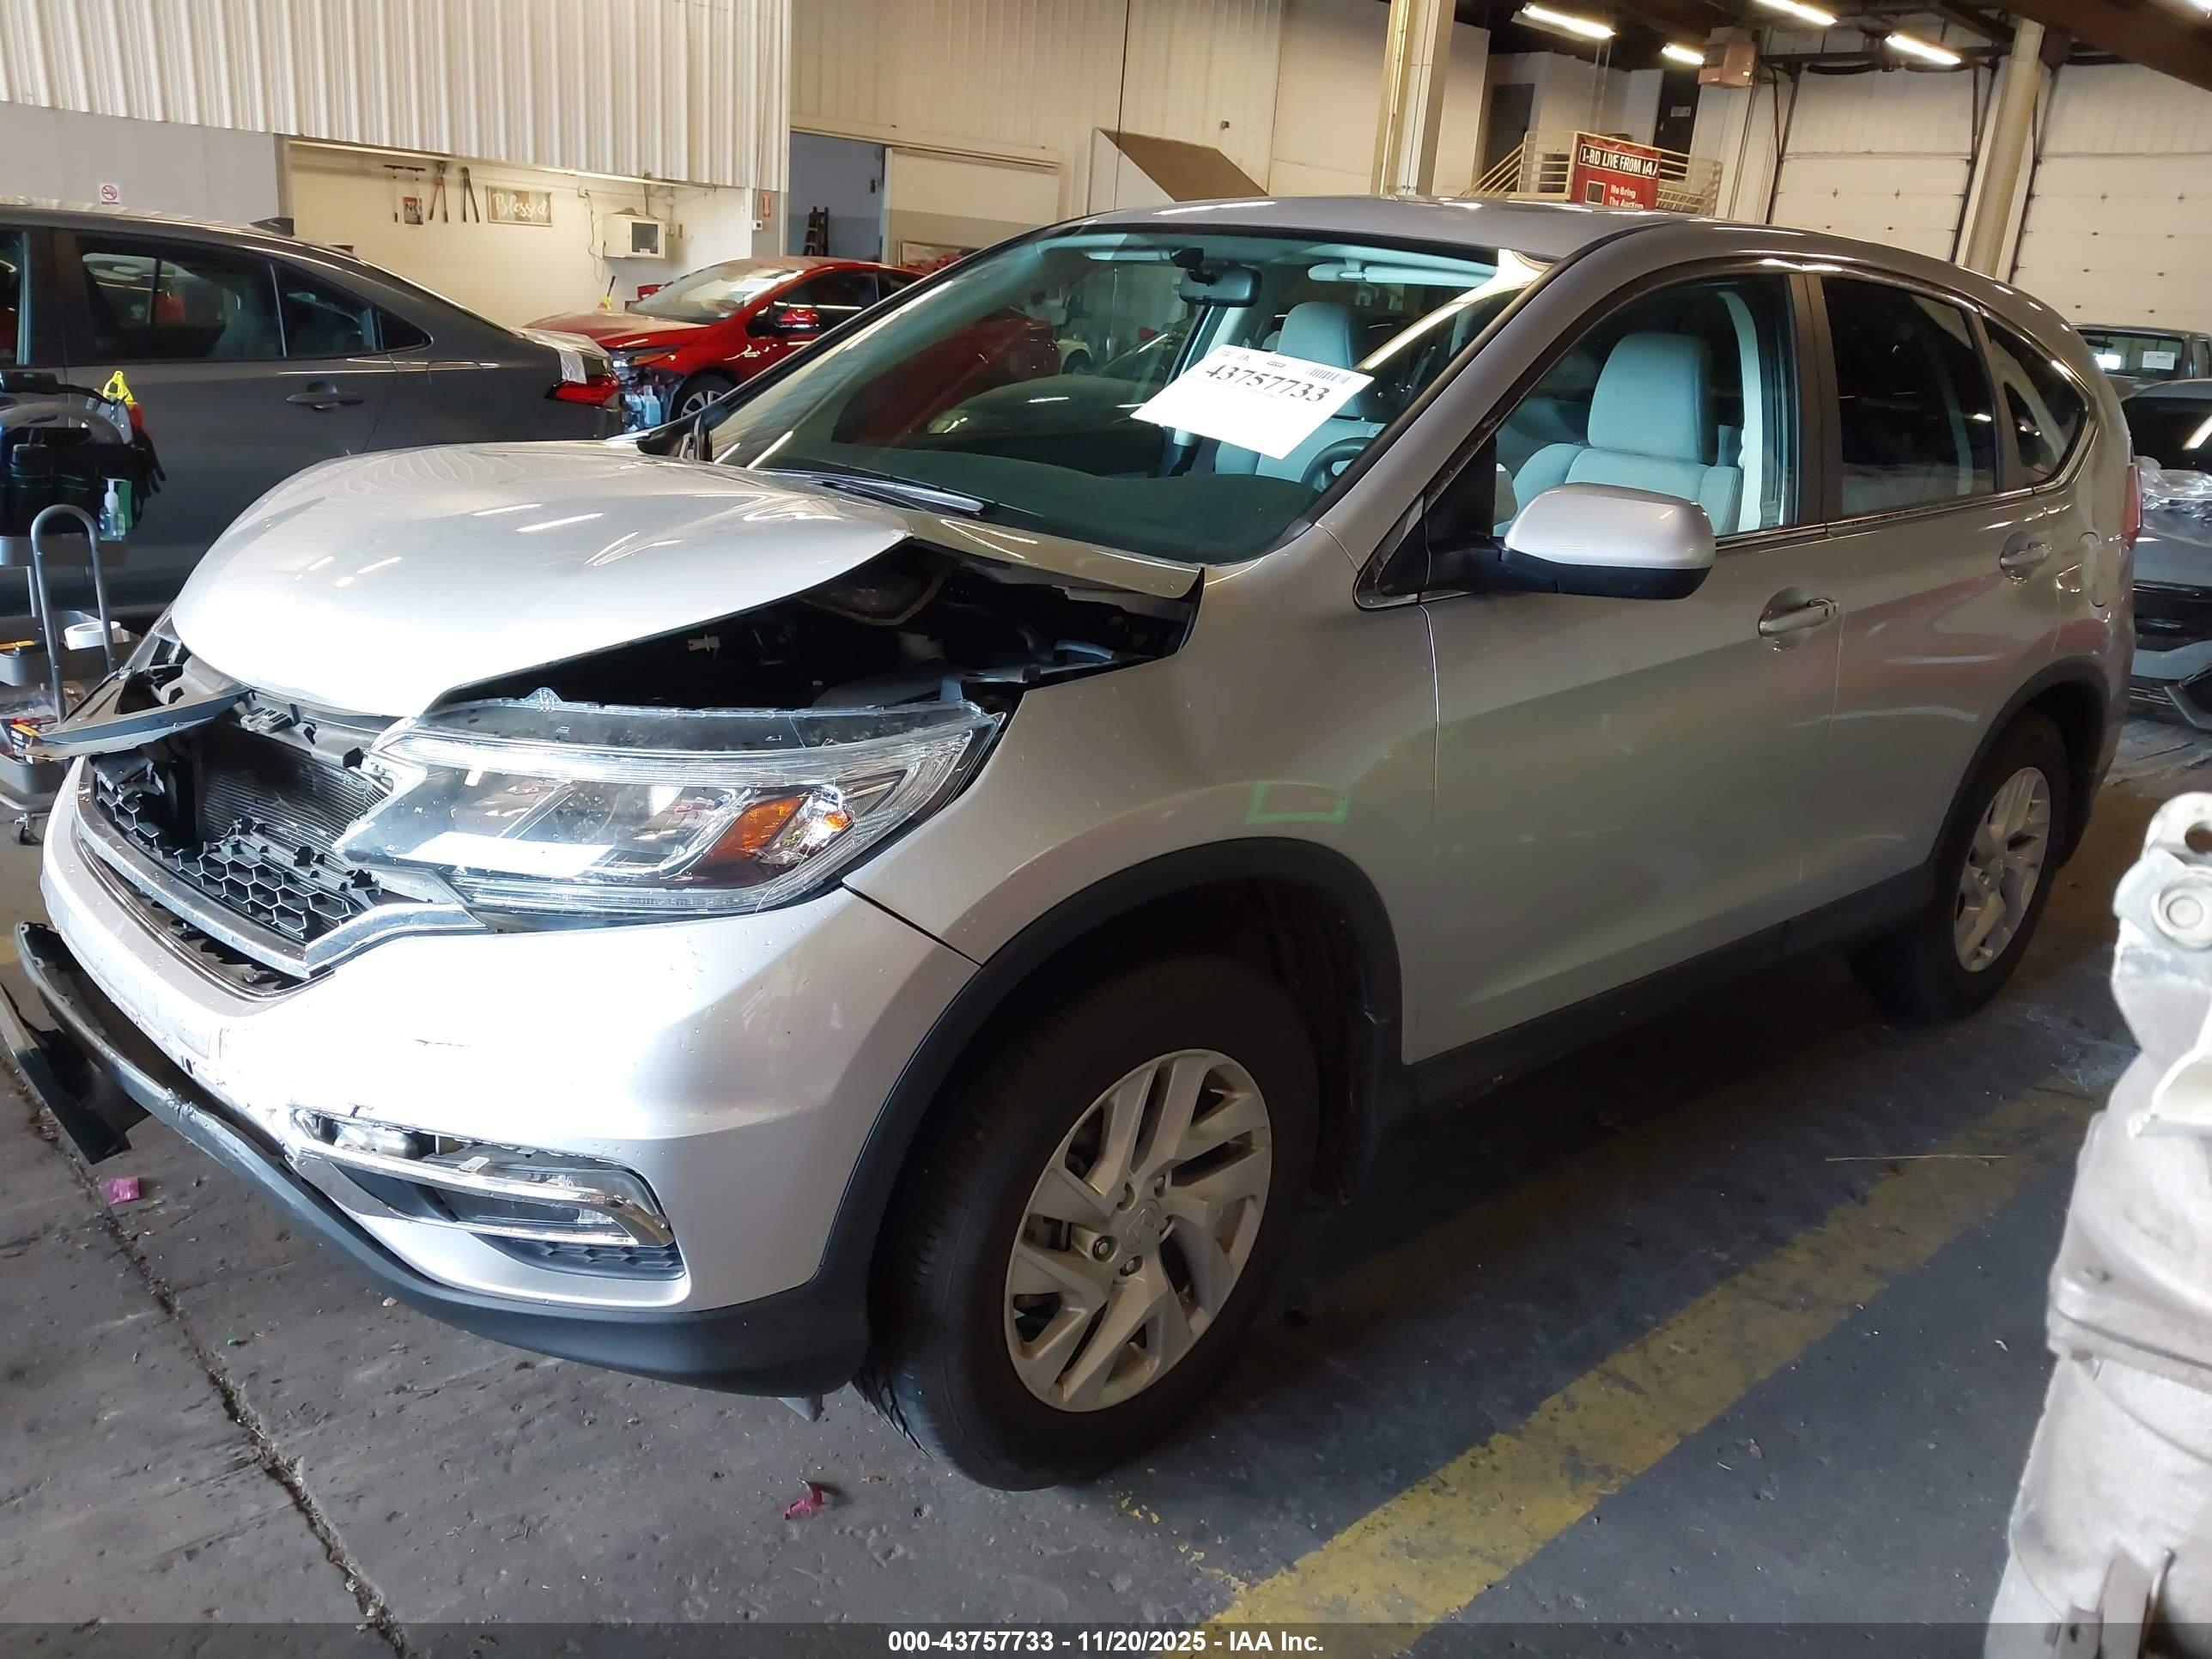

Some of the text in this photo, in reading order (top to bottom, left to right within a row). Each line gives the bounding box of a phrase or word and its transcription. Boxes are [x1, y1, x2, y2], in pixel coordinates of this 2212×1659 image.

[1601, 152, 1619, 169] LIVE
[1619, 155, 1641, 174] FROM
[1609, 196, 1620, 206] The
[1620, 185, 1637, 199] Bring
[492, 193, 550, 217] Blessed
[1206, 364, 1330, 402] 43757733
